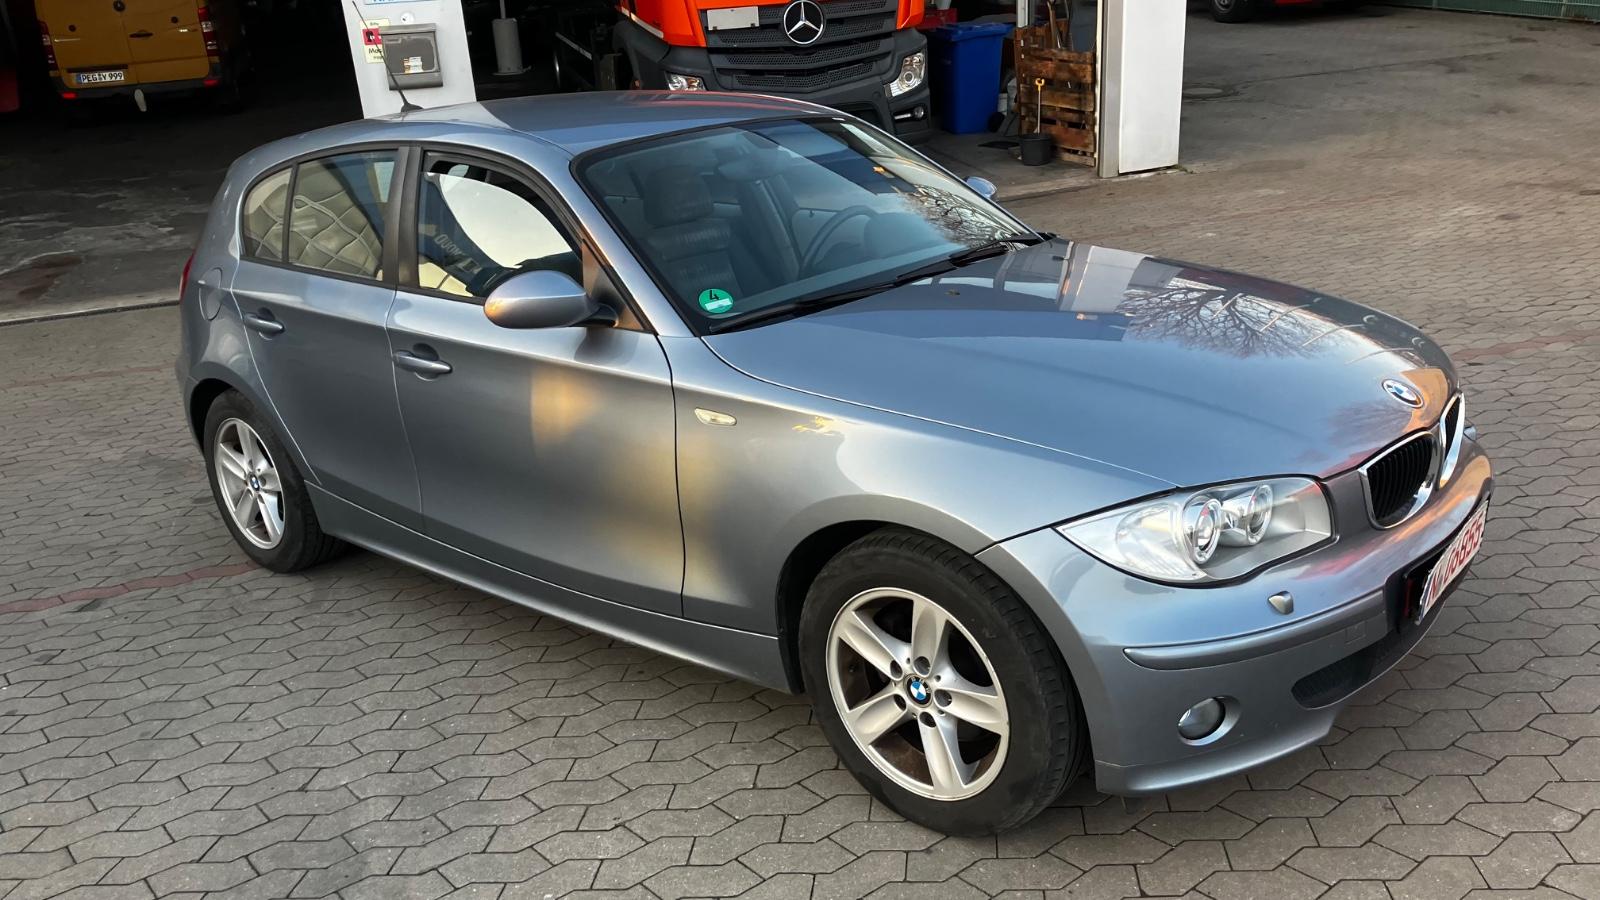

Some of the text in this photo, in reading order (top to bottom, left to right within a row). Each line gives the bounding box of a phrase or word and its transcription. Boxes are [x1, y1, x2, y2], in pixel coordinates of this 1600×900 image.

[82, 74, 98, 82] PEG
[108, 72, 123, 80] 999
[709, 289, 720, 300] 4
